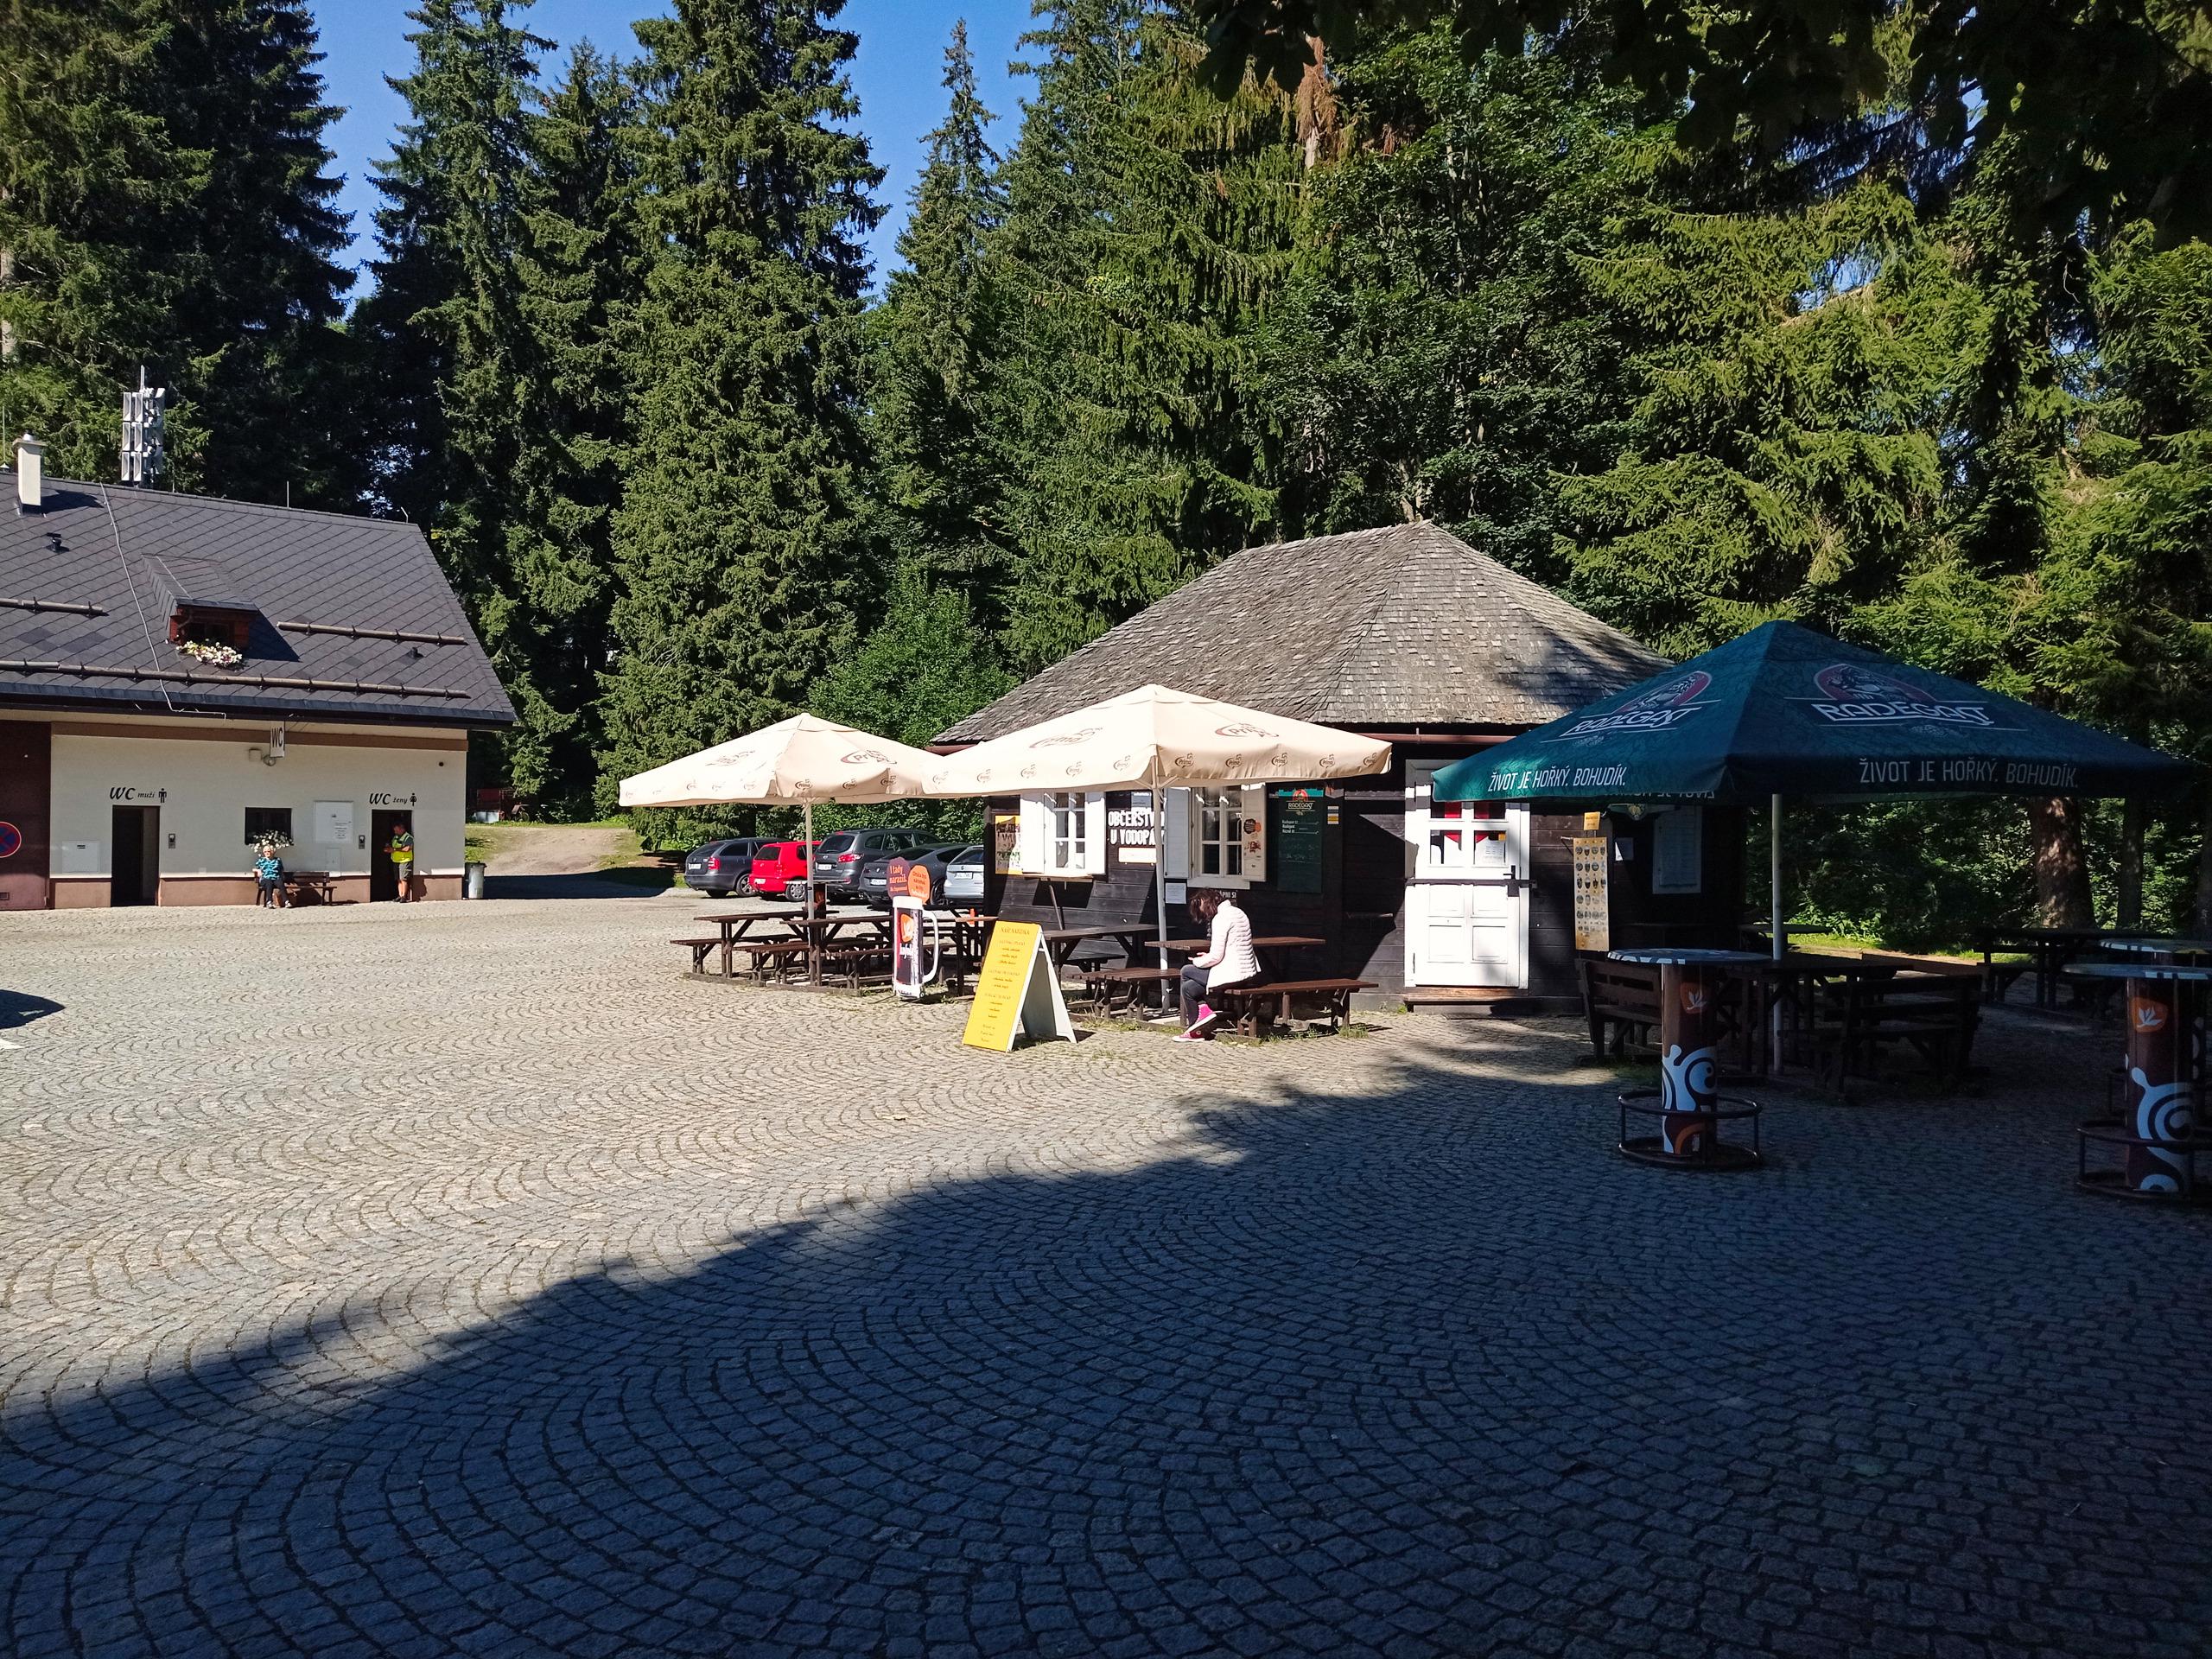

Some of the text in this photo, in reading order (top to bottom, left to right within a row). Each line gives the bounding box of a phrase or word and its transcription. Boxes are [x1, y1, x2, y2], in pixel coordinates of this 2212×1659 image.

[1559, 706, 1702, 737] RADEGAST
[1811, 702, 1994, 725] RADEGAST
[271, 727, 283, 748] WC
[1488, 763, 1627, 792] ŽIVOT JE HOŘKÝ. BOHUDÍK.
[1859, 757, 2079, 788] ŽIVOT JE HOŘKÝ. BOHUDÍK.
[109, 786, 155, 800] WC muži
[369, 792, 408, 805] WC ženy
[1108, 810, 1165, 827] OBČERSTV
[1110, 828, 1165, 845] U VODOPÁ
